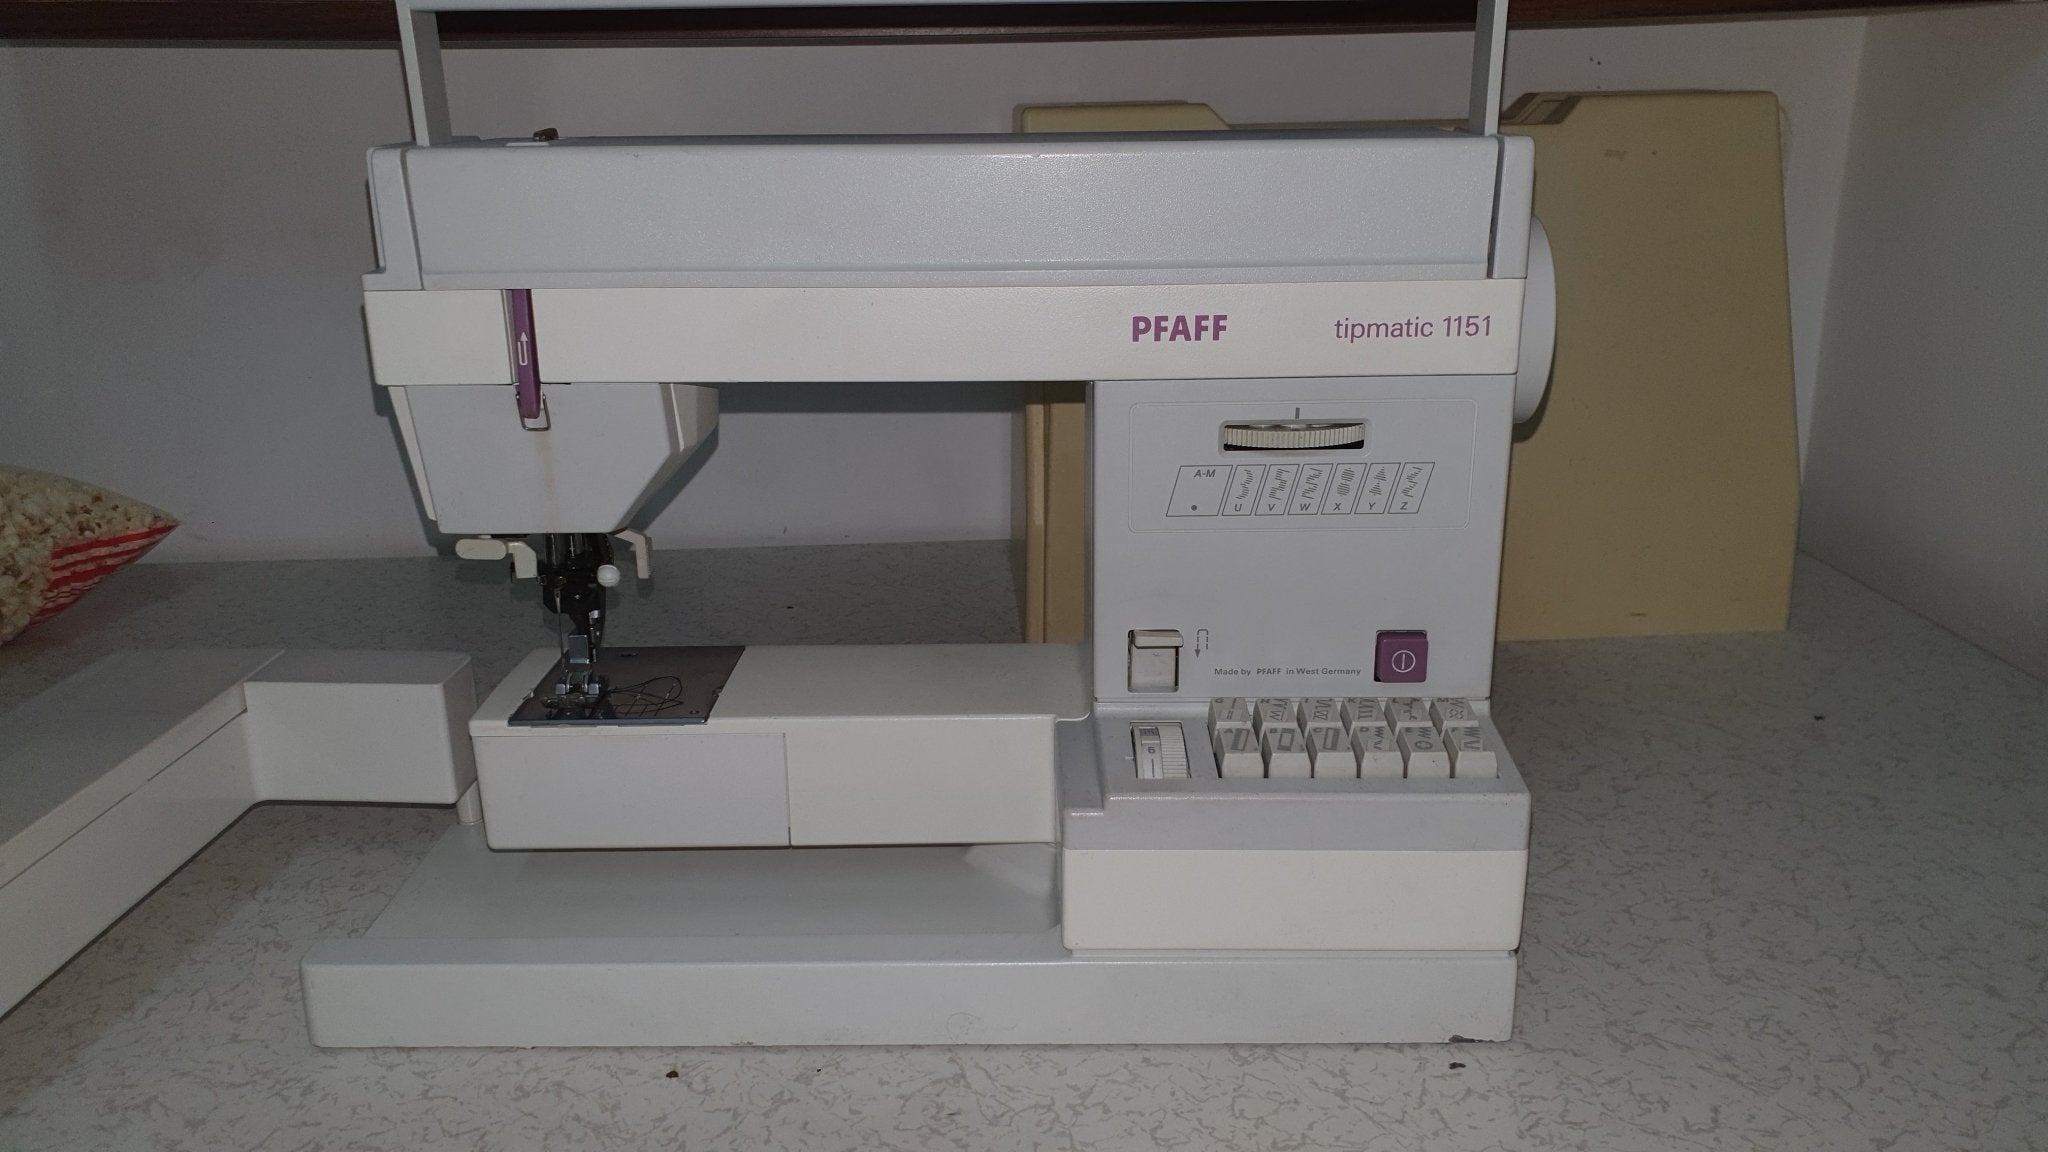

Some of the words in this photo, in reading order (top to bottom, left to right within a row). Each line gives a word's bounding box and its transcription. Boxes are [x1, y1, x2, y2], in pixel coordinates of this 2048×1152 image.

[1132, 314, 1228, 342] PFAFF
[1334, 317, 1434, 343] tipmatic
[1443, 315, 1491, 337] 1151
[1193, 468, 1216, 478] A-M
[1234, 503, 1242, 512] U
[1268, 503, 1276, 512] V
[1300, 503, 1311, 511] W
[1333, 502, 1342, 511] X
[1368, 502, 1377, 511] Y
[1400, 501, 1408, 511] Z
[1214, 668, 1239, 676] Made
[1240, 667, 1251, 677] by
[1256, 667, 1282, 675] PFAFF
[1286, 667, 1294, 675] in
[1296, 667, 1319, 675] West
[1321, 667, 1362, 676] Germany
